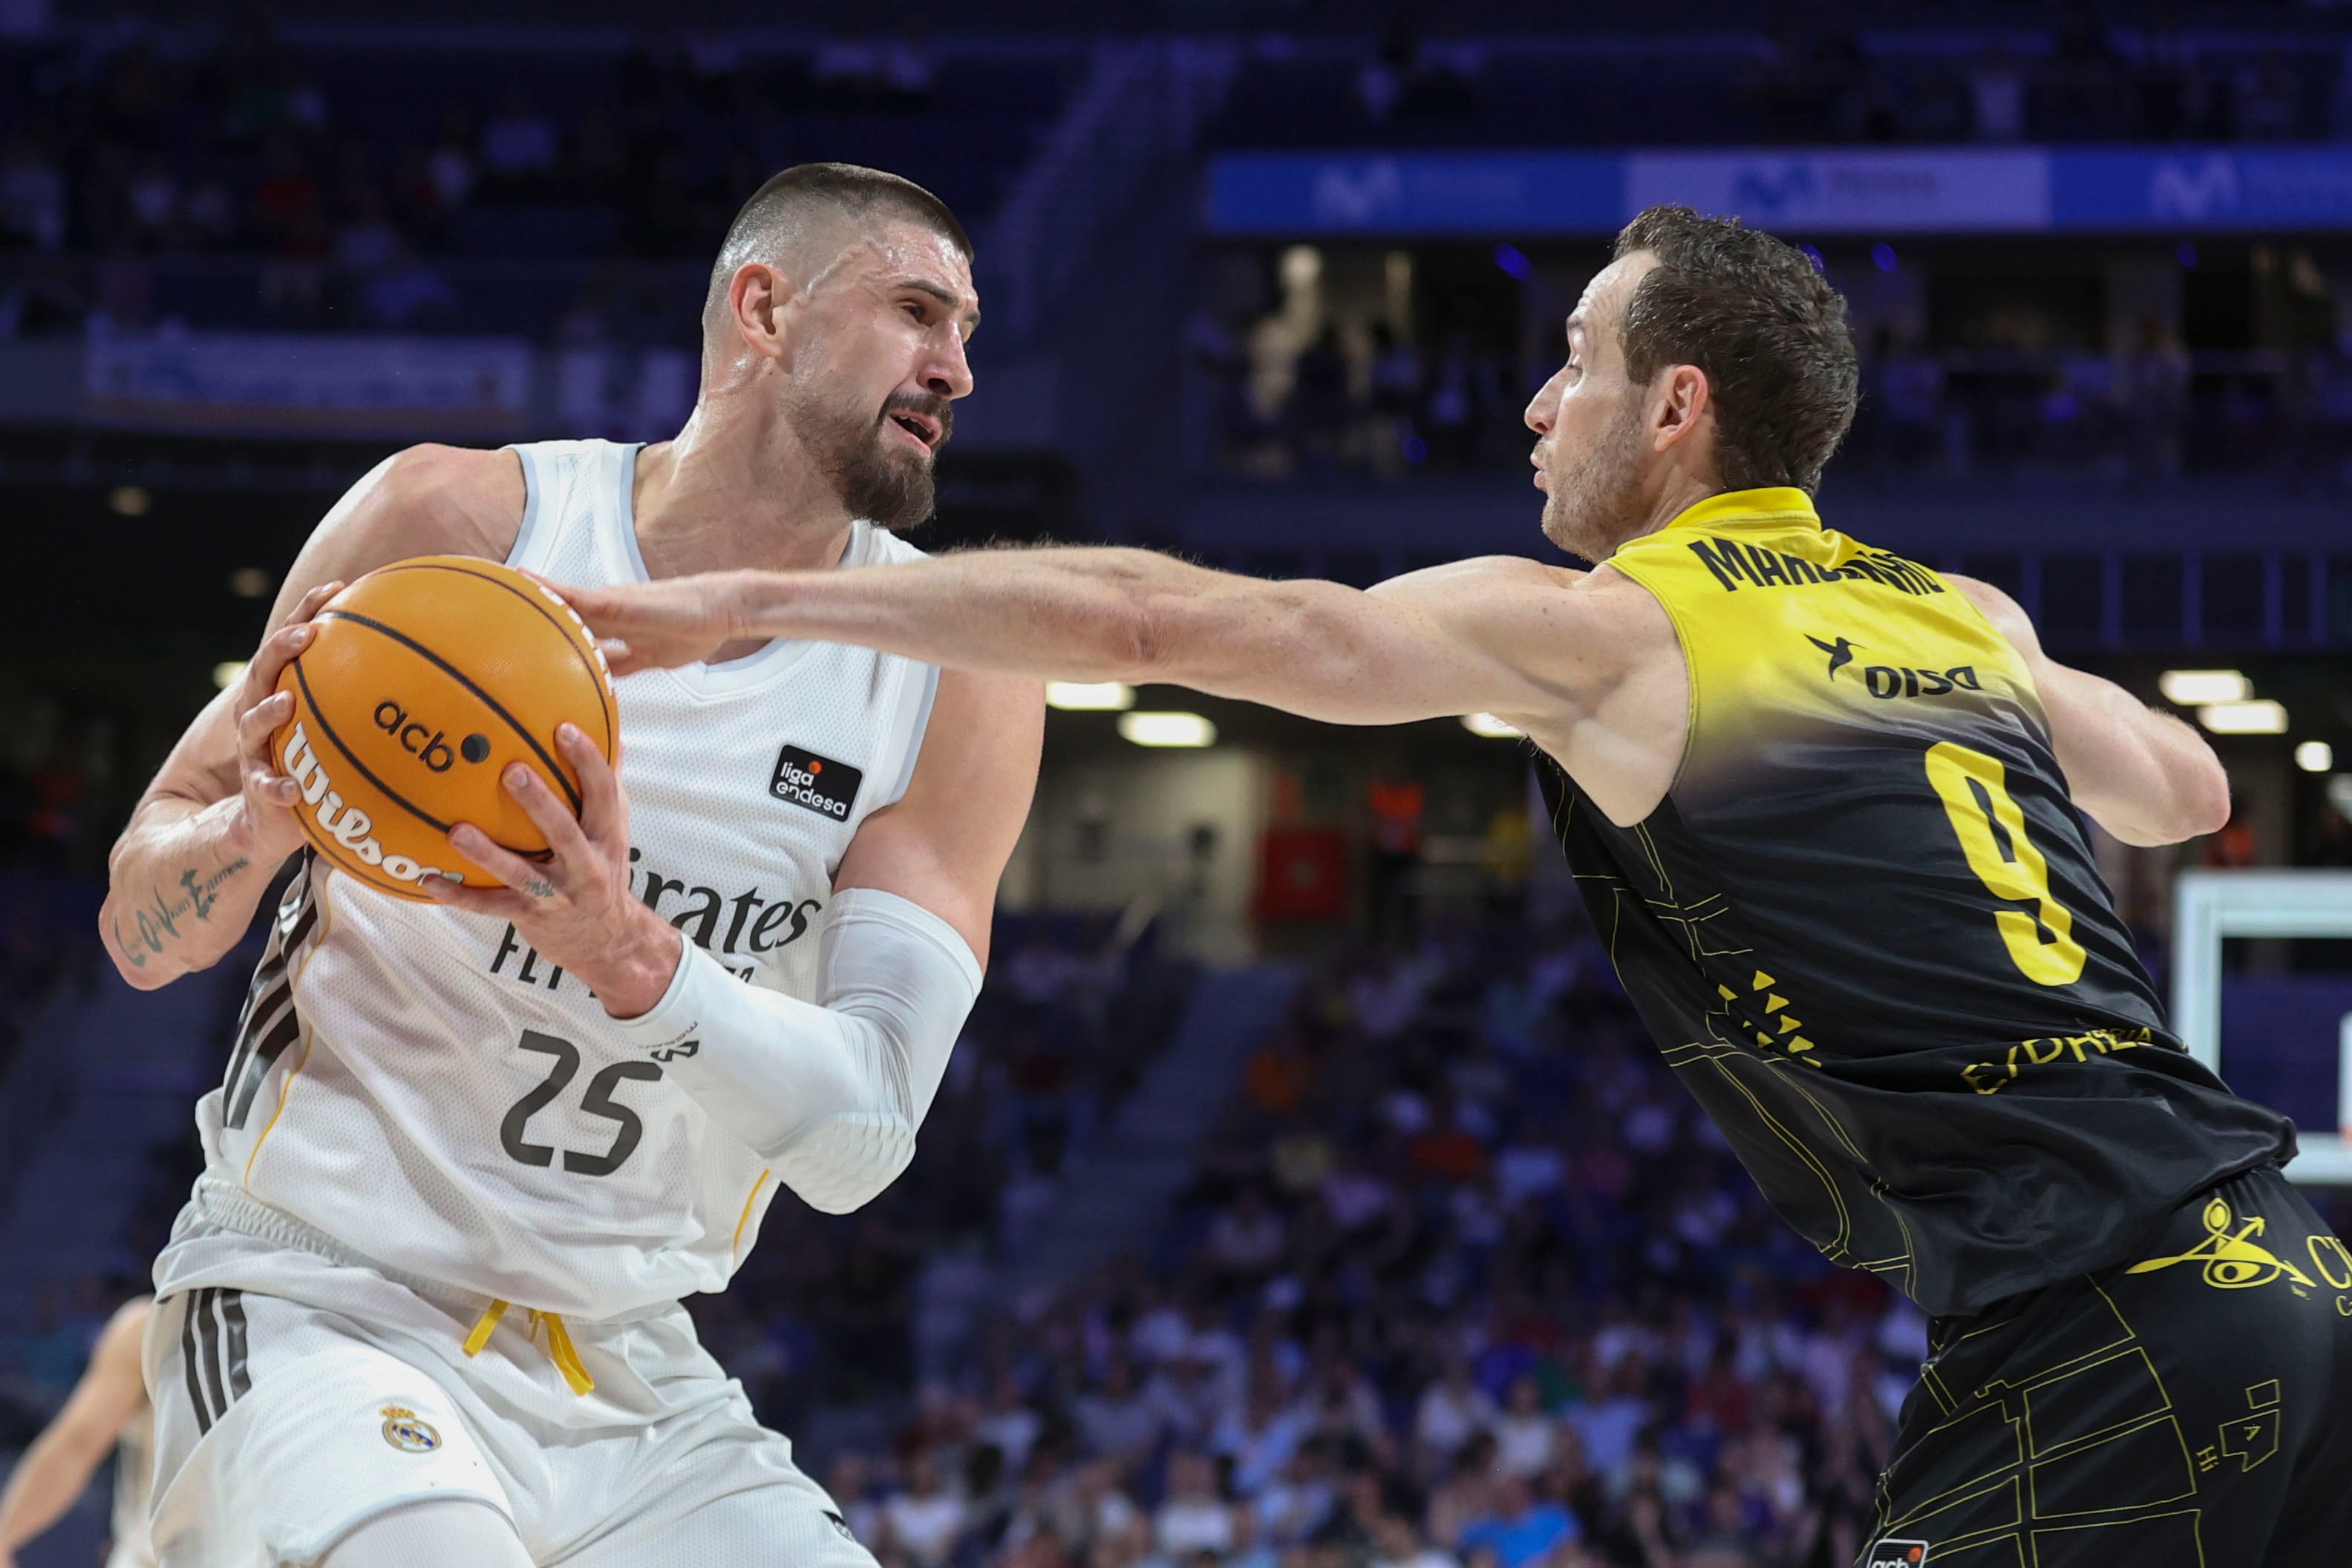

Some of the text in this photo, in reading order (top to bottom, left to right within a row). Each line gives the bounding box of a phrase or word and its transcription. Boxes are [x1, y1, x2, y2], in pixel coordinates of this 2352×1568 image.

[373, 700, 454, 773] acb
[776, 781, 847, 817] endesa
[780, 762, 814, 787] liga
[1925, 741, 2086, 986] 9
[500, 1029, 664, 1177] 25
